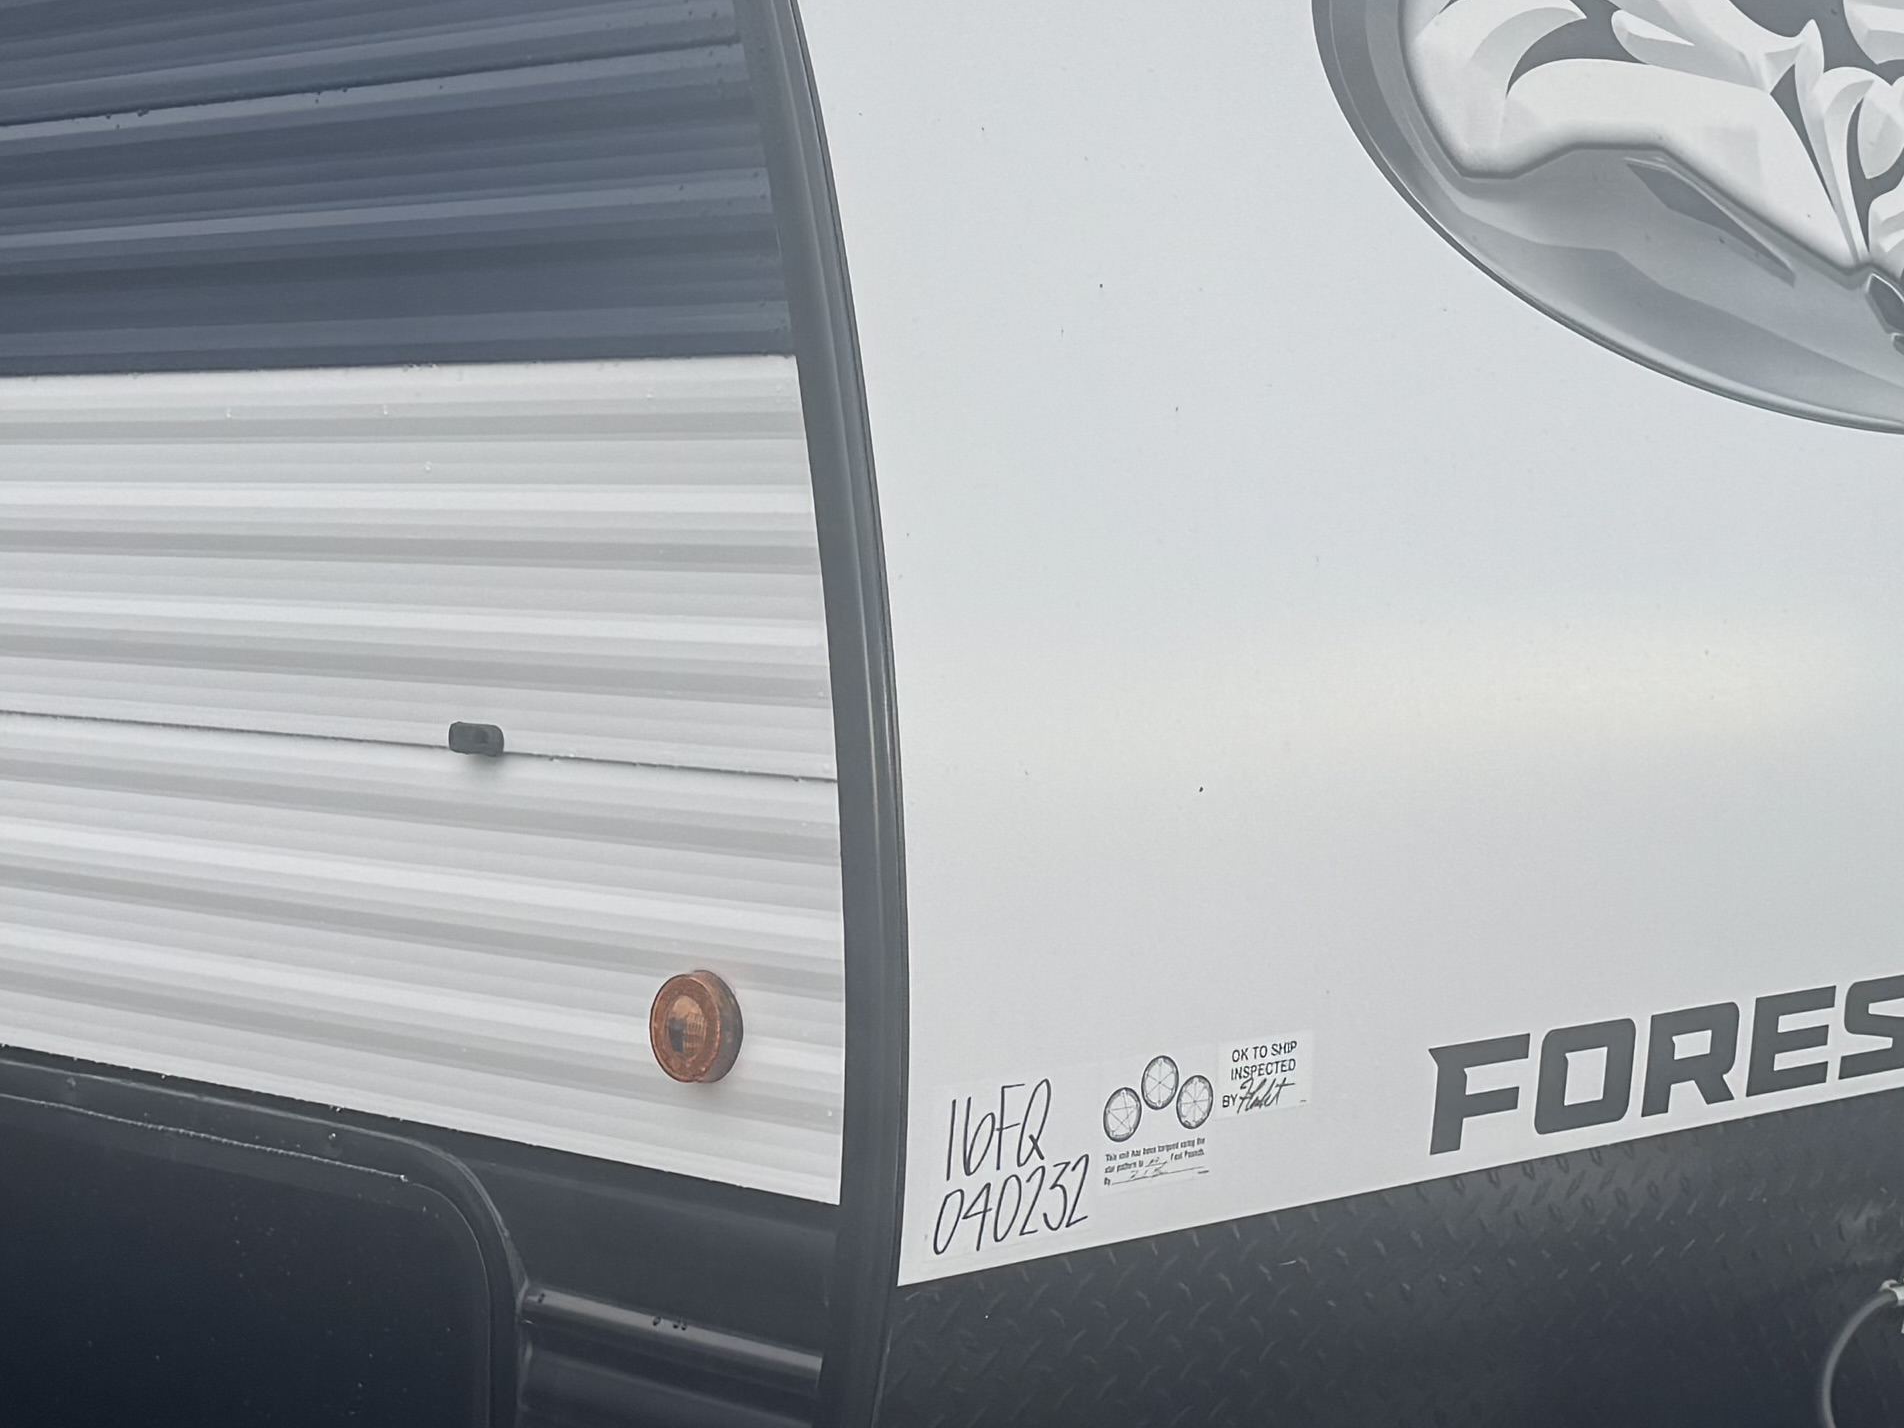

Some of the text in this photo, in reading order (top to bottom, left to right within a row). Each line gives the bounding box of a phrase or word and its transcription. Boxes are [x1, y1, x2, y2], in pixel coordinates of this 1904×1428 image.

[1231, 1040, 1298, 1063] OK TO SHIP
[1231, 1058, 1297, 1080] INSPECTED
[1222, 1093, 1238, 1109] BY
[933, 1154, 1089, 1255] 040232
